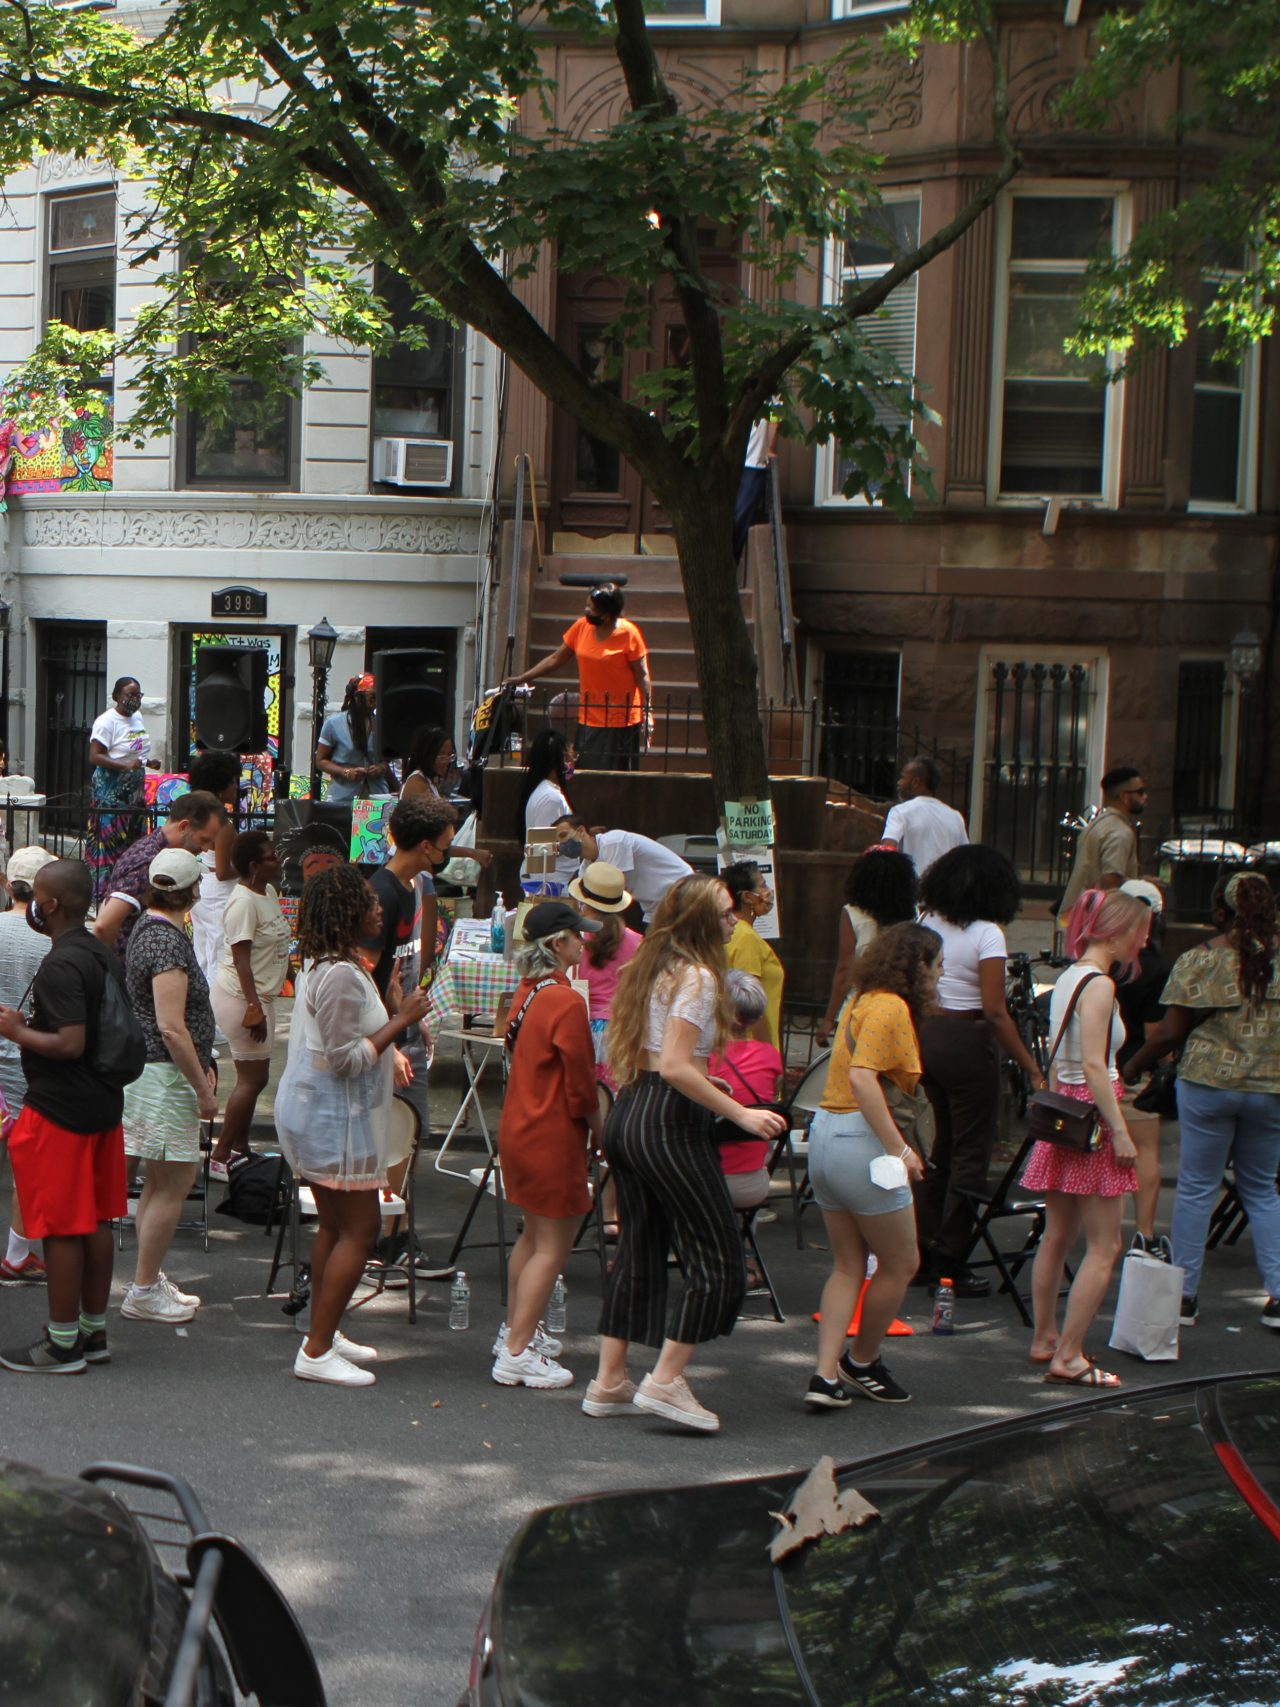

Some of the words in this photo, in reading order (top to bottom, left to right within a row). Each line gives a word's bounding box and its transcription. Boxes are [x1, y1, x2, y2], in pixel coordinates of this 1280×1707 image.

[224, 595, 252, 611] 398
[744, 804, 760, 815] NO
[729, 815, 772, 827] PARKING
[729, 828, 773, 840] SATURDAY
